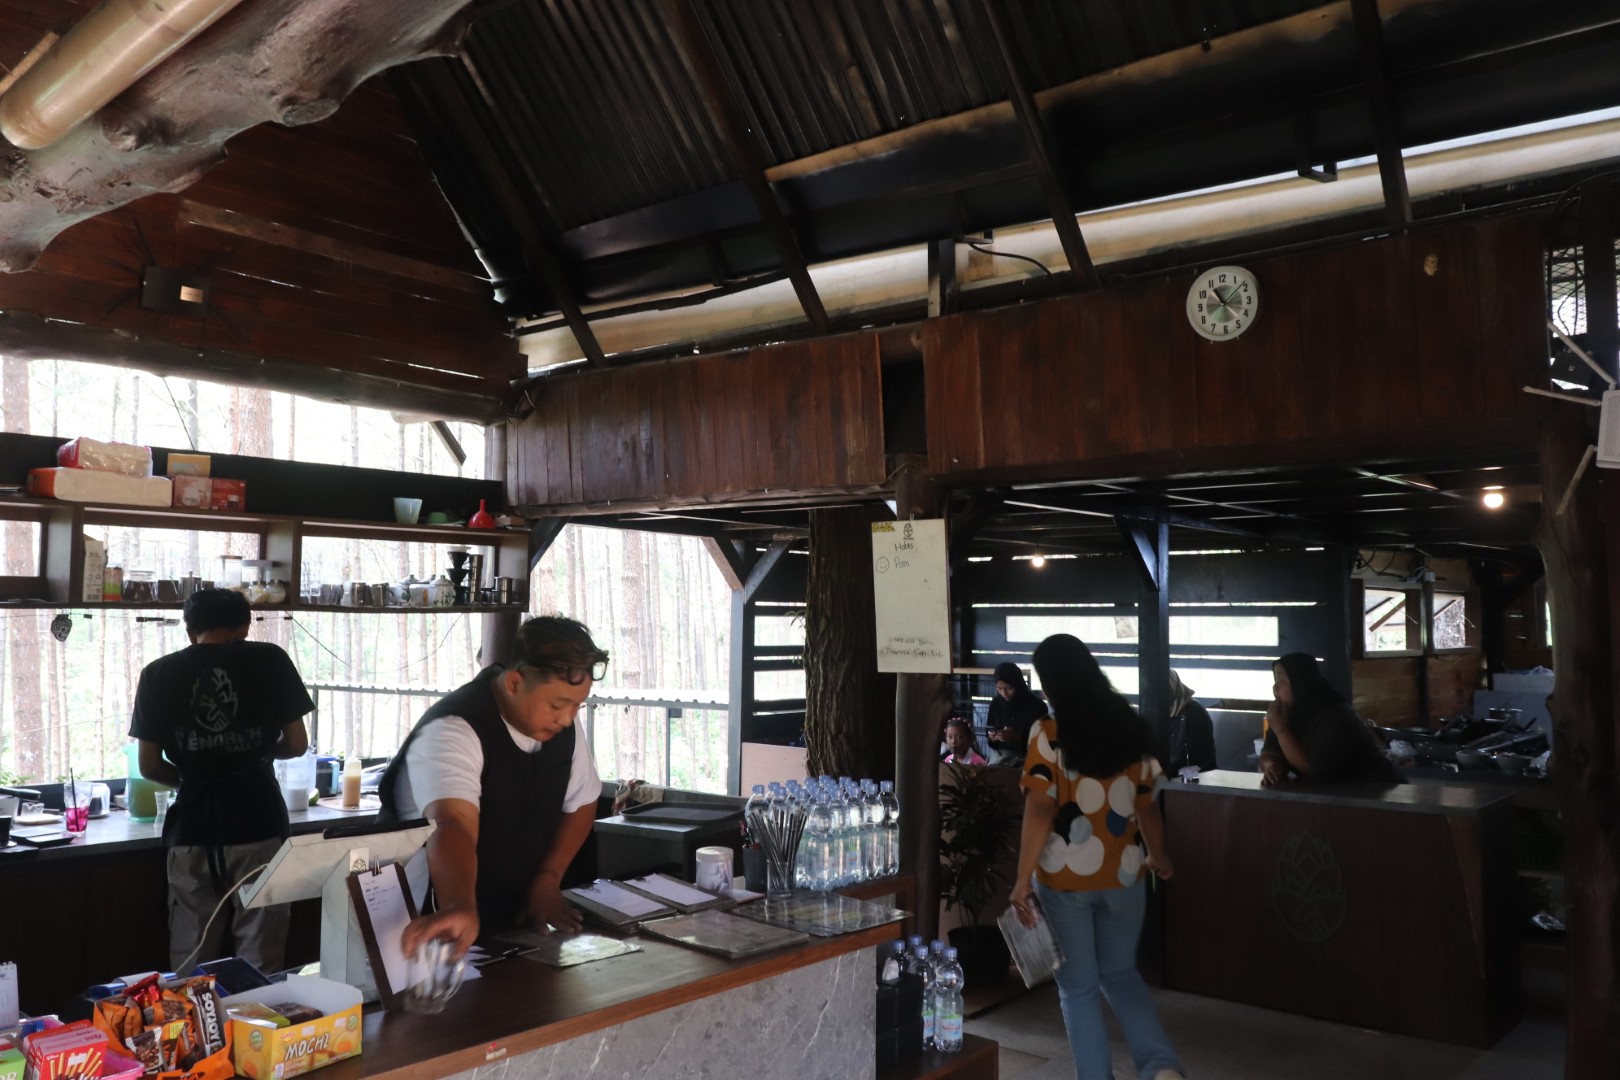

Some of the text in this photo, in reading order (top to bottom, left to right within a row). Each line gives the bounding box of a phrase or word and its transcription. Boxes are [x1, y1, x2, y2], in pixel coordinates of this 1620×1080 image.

[1218, 274, 1226, 283] 12
[1234, 276, 1236, 284] 1
[1208, 279, 1214, 288] 11
[1243, 283, 1248, 292] 2
[1199, 290, 1207, 299] 10
[1246, 296, 1252, 305] 3
[1198, 303, 1203, 312] 9
[1243, 309, 1249, 318] 4
[1201, 315, 1206, 324] 8
[1211, 323, 1216, 332] 7
[1235, 320, 1241, 329] 5
[1223, 325, 1229, 334] 6
[201, 991, 220, 1041] SOYJOY
